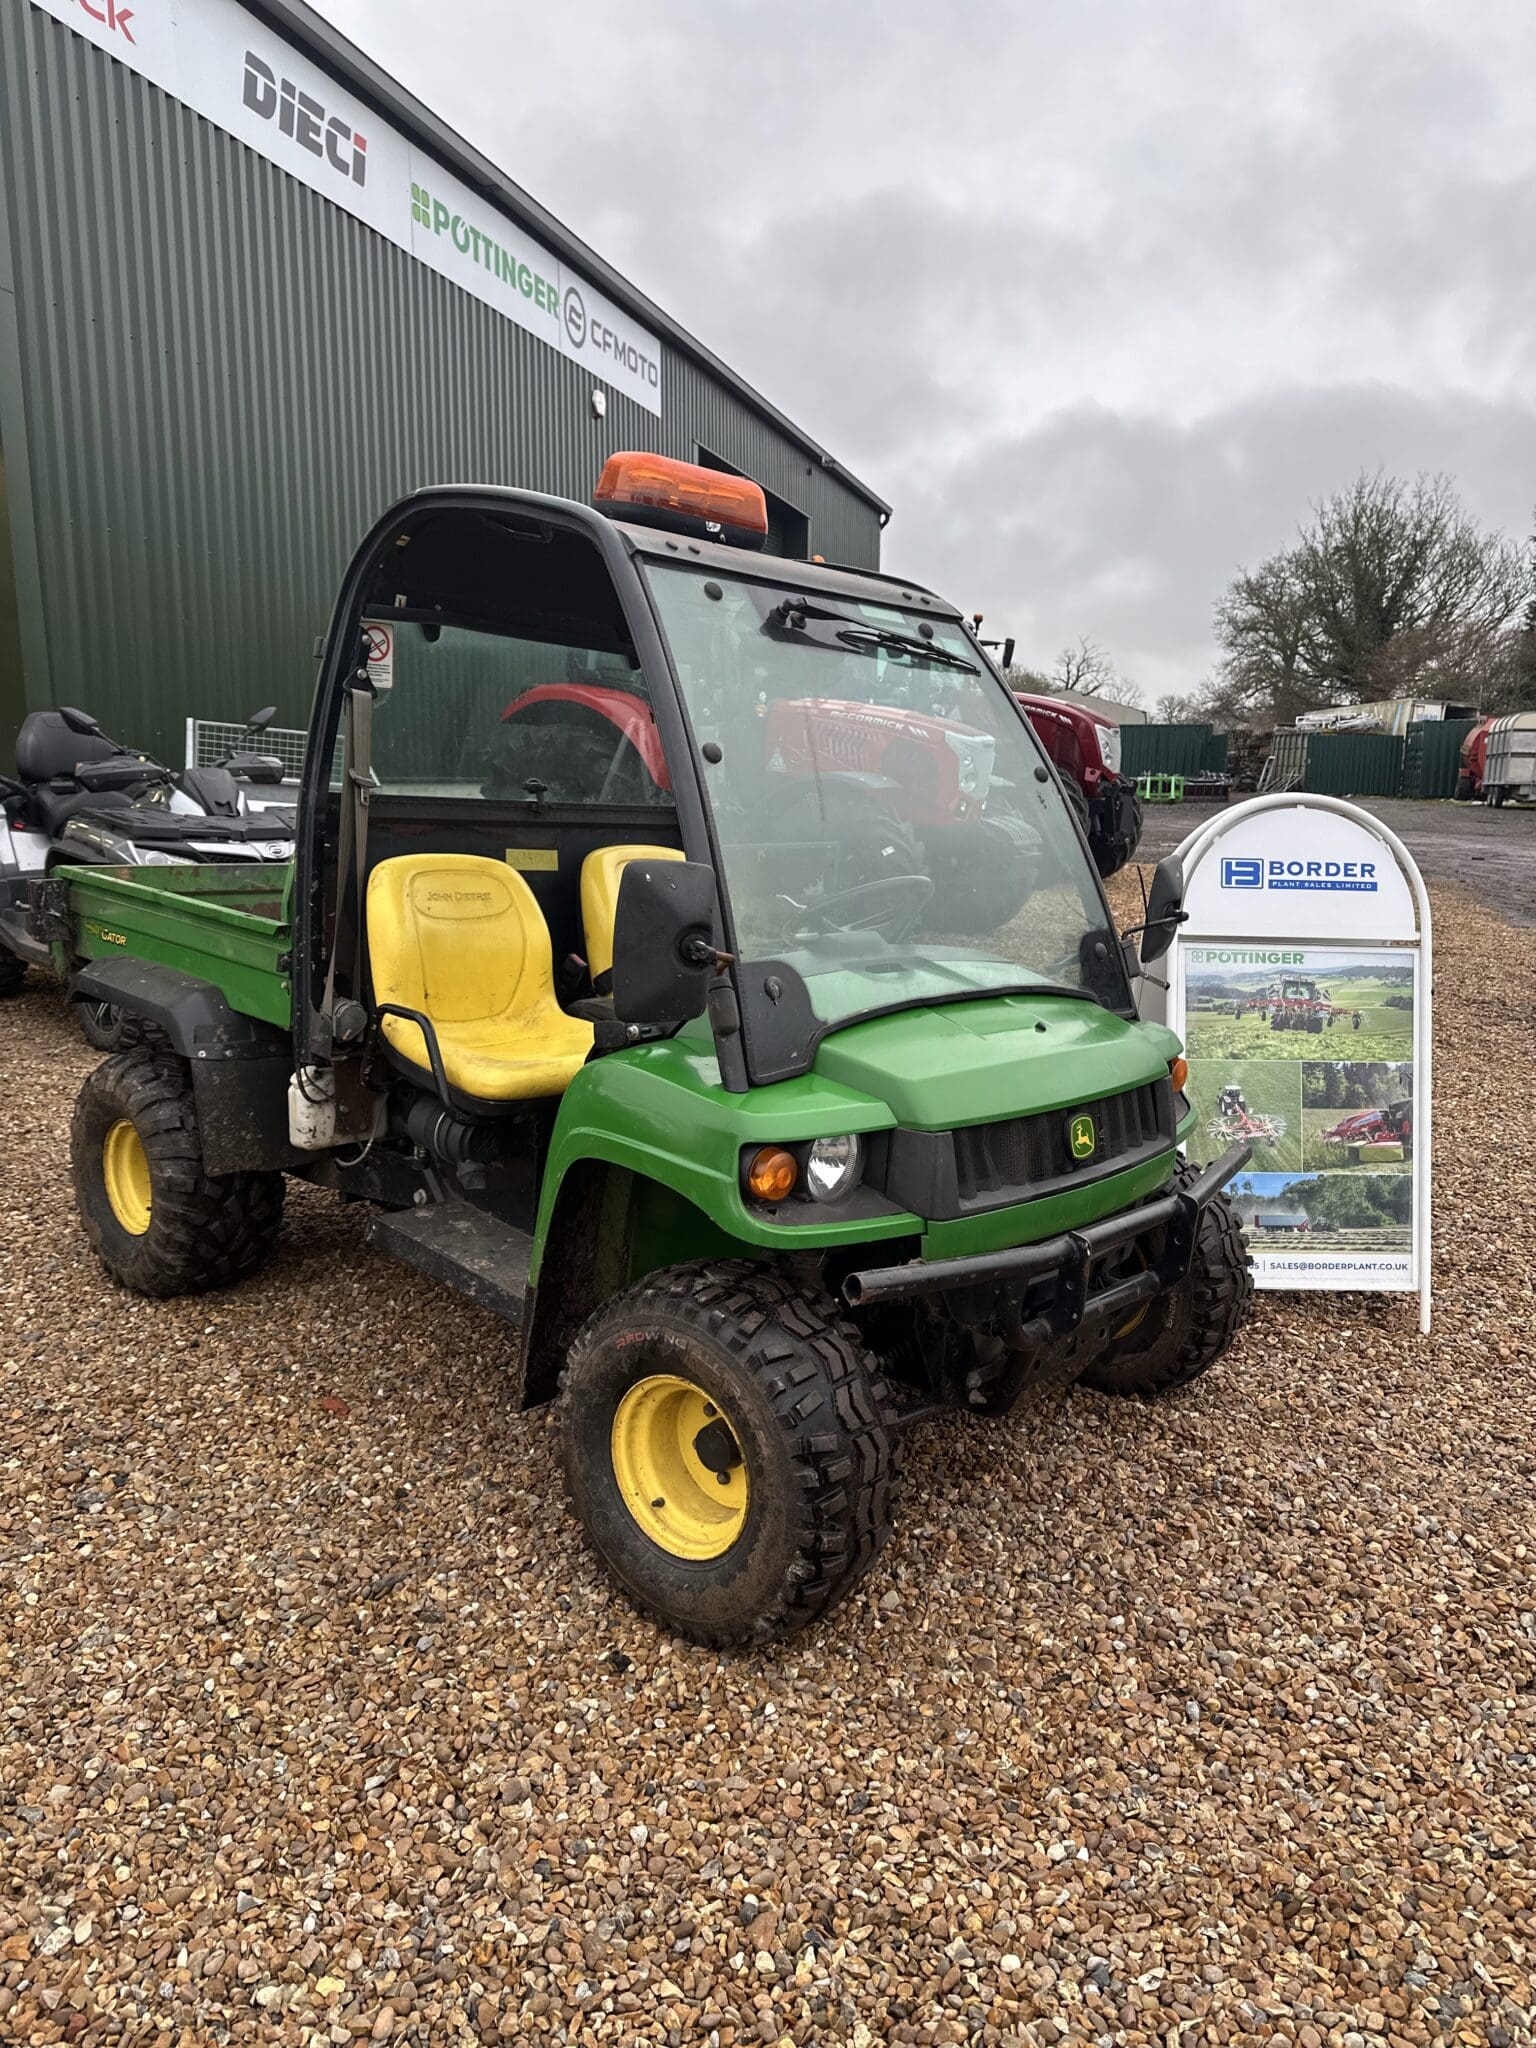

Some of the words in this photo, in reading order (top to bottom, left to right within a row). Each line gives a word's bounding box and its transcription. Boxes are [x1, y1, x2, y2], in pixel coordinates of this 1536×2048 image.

[591, 319, 658, 389] CFMOTO
[1269, 861, 1376, 878] BORDER
[101, 929, 127, 946] GATOR
[1270, 1262, 1408, 1271] SALES@BORDERPLANT.CO.UK
